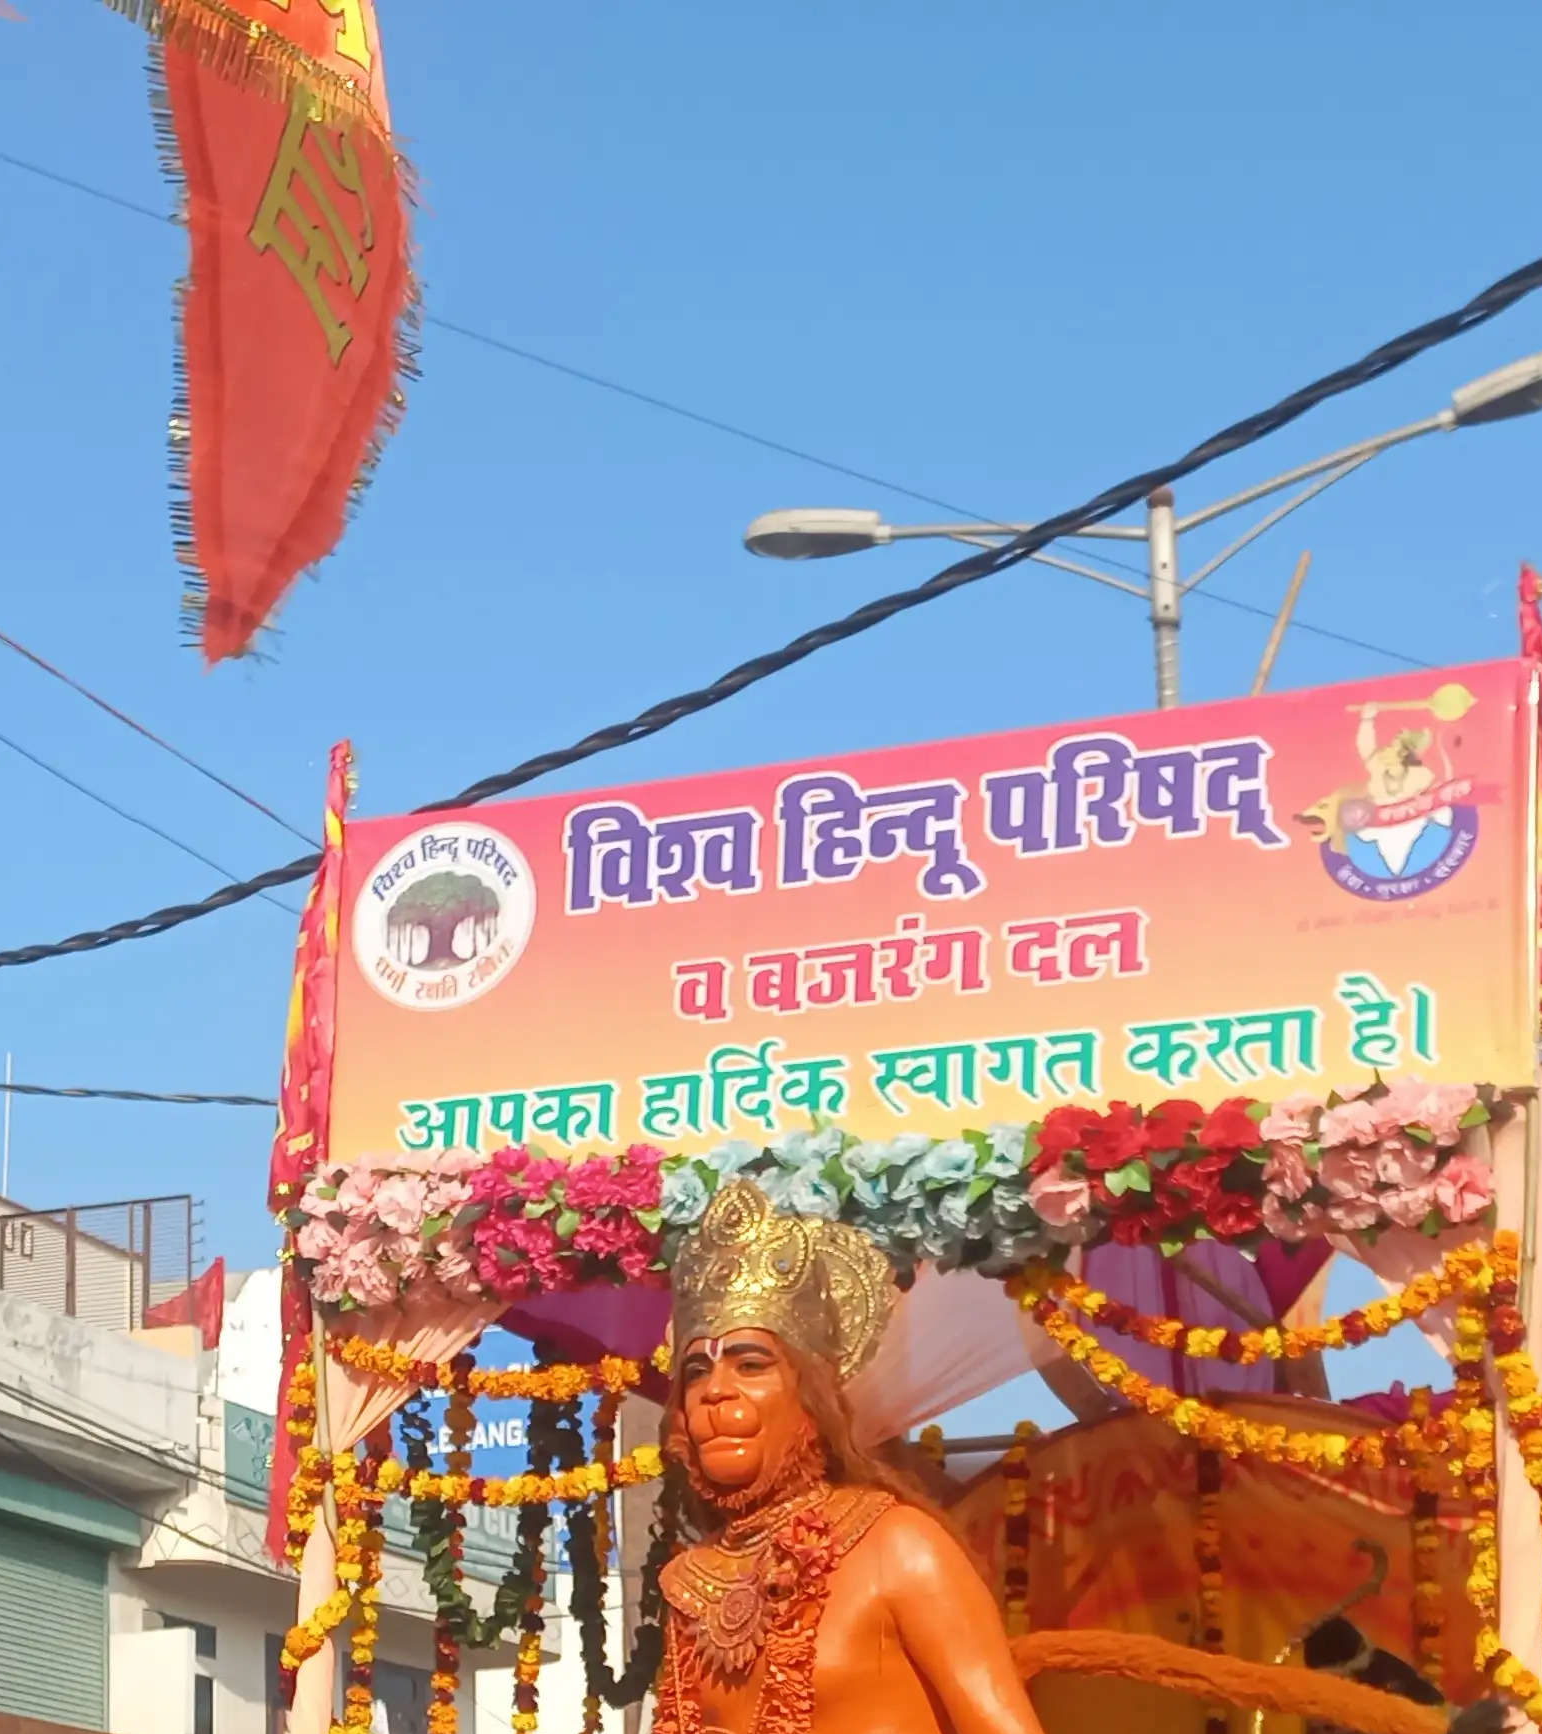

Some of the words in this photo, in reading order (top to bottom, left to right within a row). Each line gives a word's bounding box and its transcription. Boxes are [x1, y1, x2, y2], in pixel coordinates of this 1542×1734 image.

[566, 803, 759, 912] विश्व
[778, 774, 982, 897] हिन्दू
[984, 736, 1285, 853] परिषद्
[676, 961, 727, 1020] व
[749, 917, 985, 1012] बजरंग
[1008, 911, 1144, 981] दल
[399, 1083, 618, 1149] आपका
[640, 1040, 849, 1137] हार्दिक
[871, 1030, 1099, 1113] स्वागत
[1128, 1008, 1322, 1085] करता
